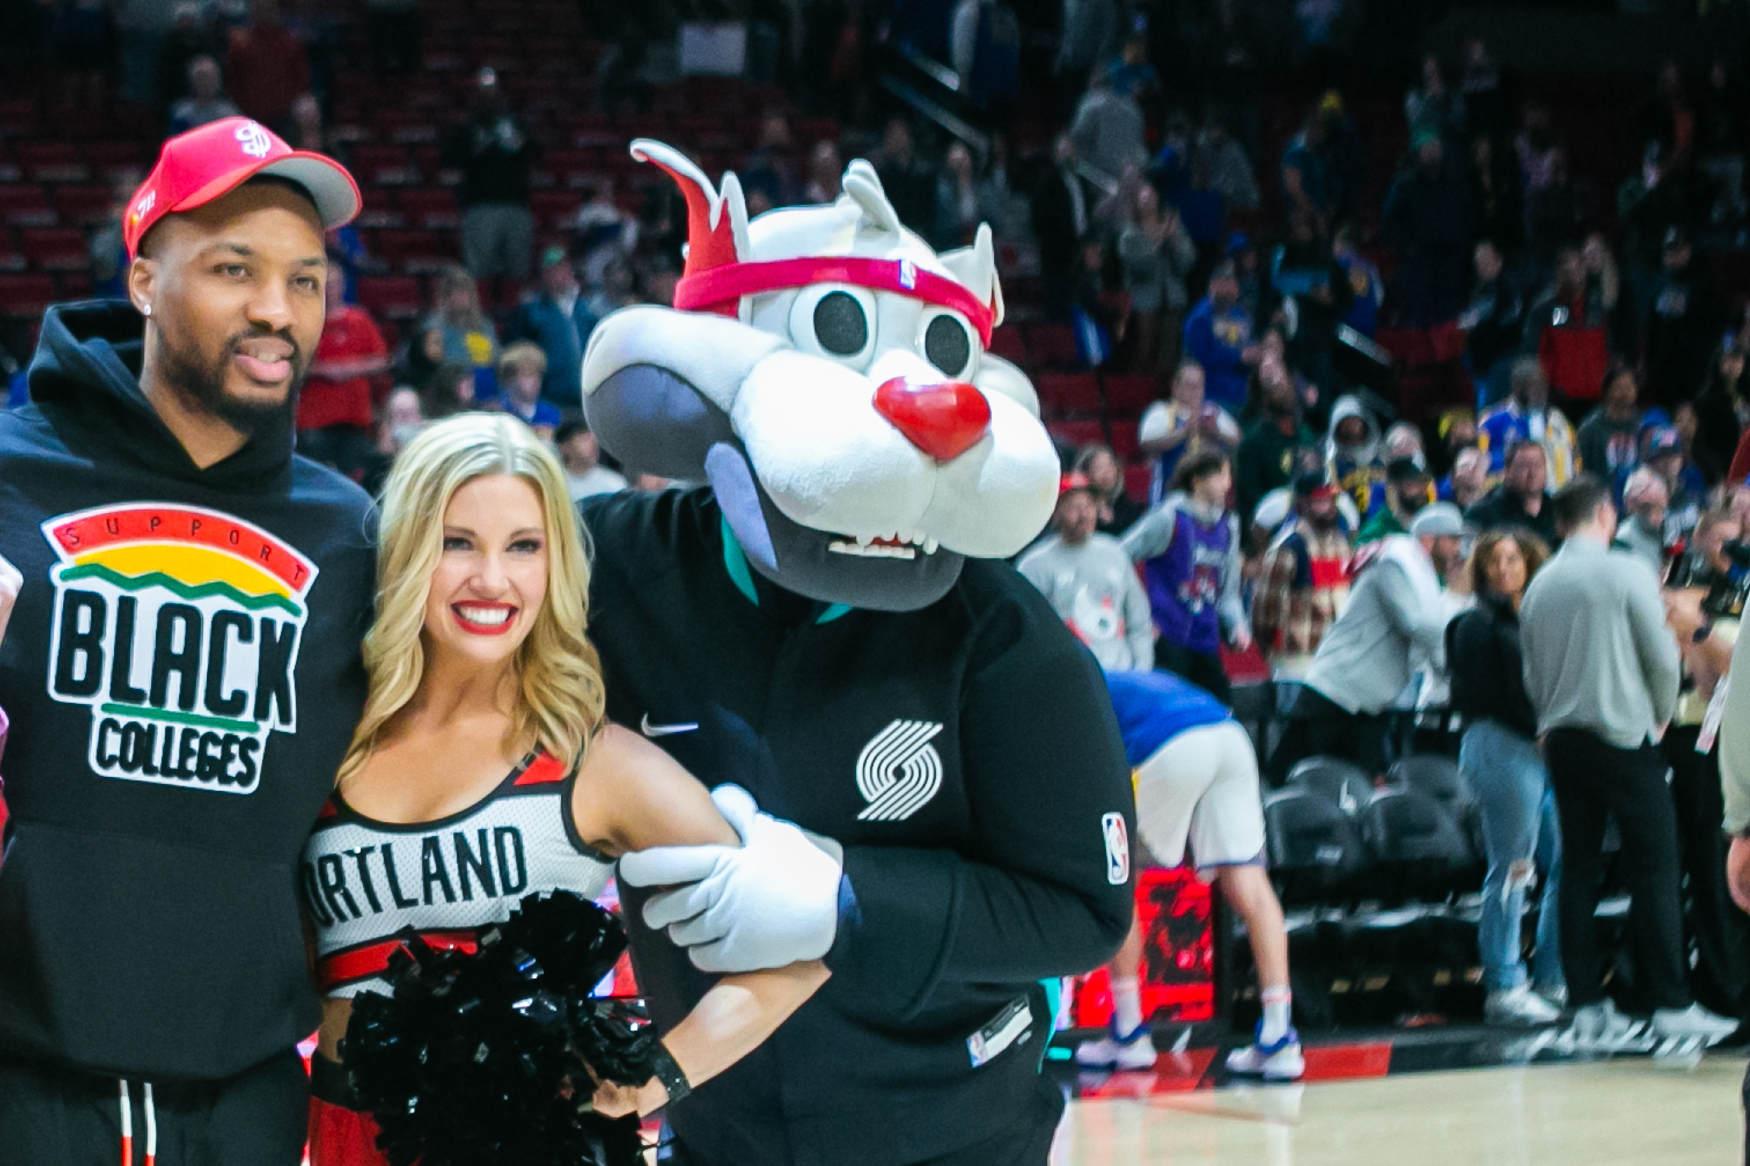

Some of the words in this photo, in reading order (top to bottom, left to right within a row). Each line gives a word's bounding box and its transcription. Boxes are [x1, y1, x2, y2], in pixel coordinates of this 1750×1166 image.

[65, 515, 305, 581] SUPPORT
[54, 588, 297, 726] BLACK
[96, 717, 260, 788] COLLEGES
[299, 825, 528, 927] ORTLAND
